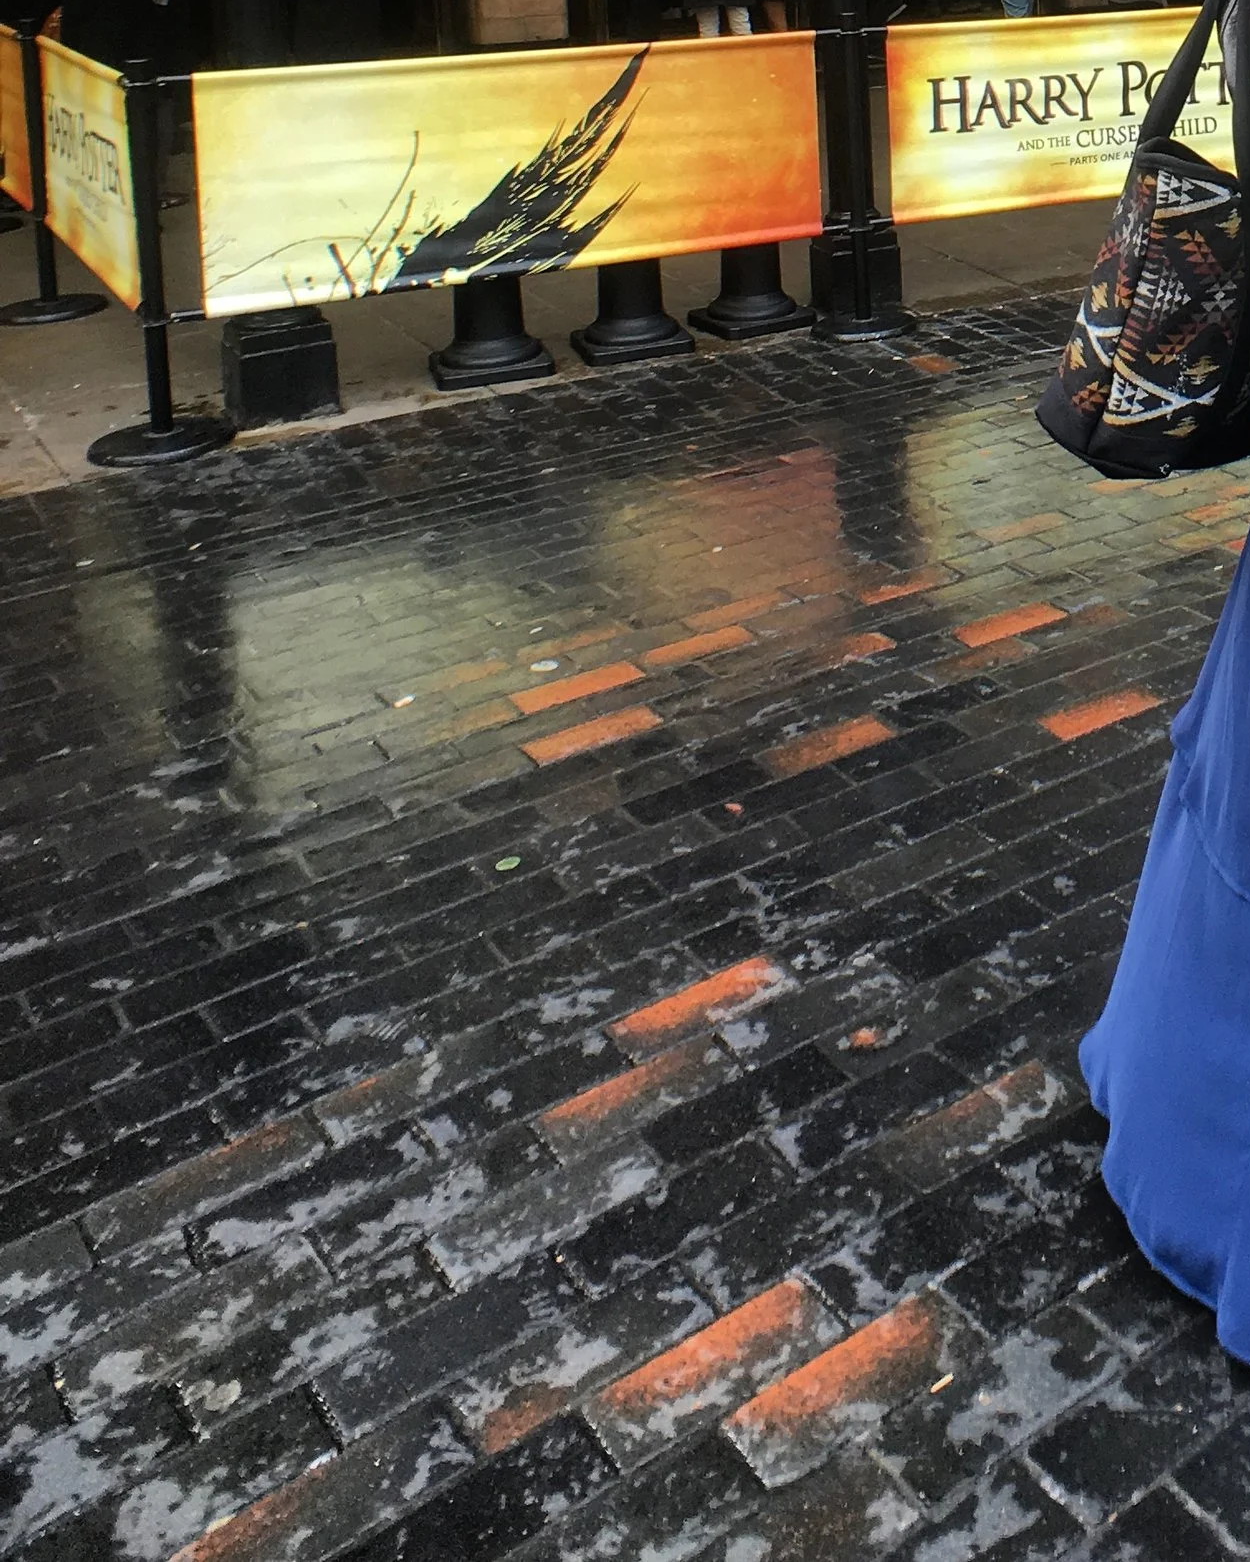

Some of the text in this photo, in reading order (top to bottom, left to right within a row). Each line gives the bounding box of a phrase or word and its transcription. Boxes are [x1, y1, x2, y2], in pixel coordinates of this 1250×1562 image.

[927, 67, 1104, 134] HARRY
[1017, 116, 1218, 152] AND THE CURSE HILD
[1069, 150, 1136, 167] PARTS ONE AN
